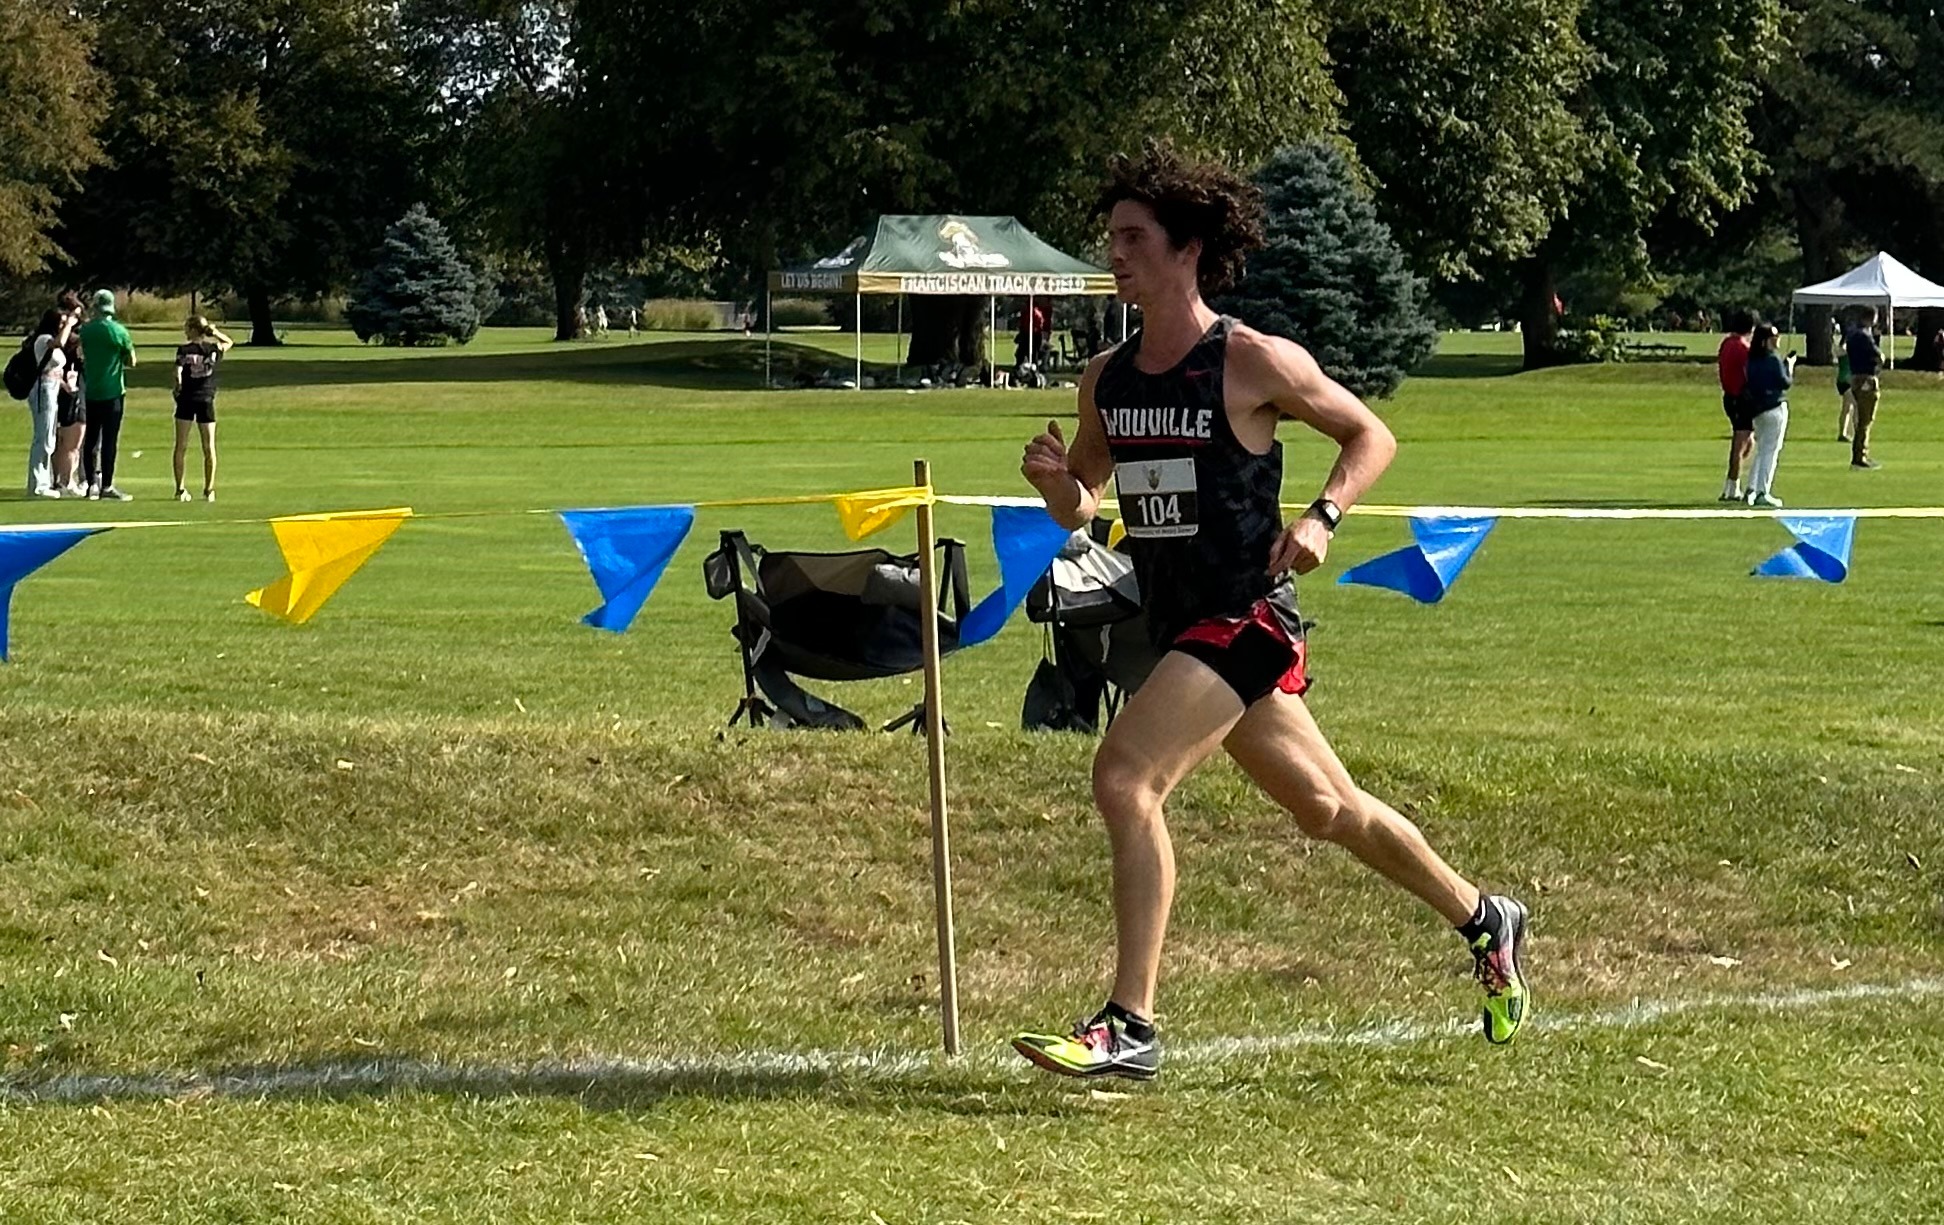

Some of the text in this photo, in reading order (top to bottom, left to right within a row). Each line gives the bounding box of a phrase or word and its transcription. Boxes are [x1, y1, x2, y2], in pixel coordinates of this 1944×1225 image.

[780, 273, 795, 289] LET
[797, 273, 810, 289] US
[900, 275, 1086, 292] FRANCISCAN TRACK & FIELD
[1137, 494, 1181, 526] 104
